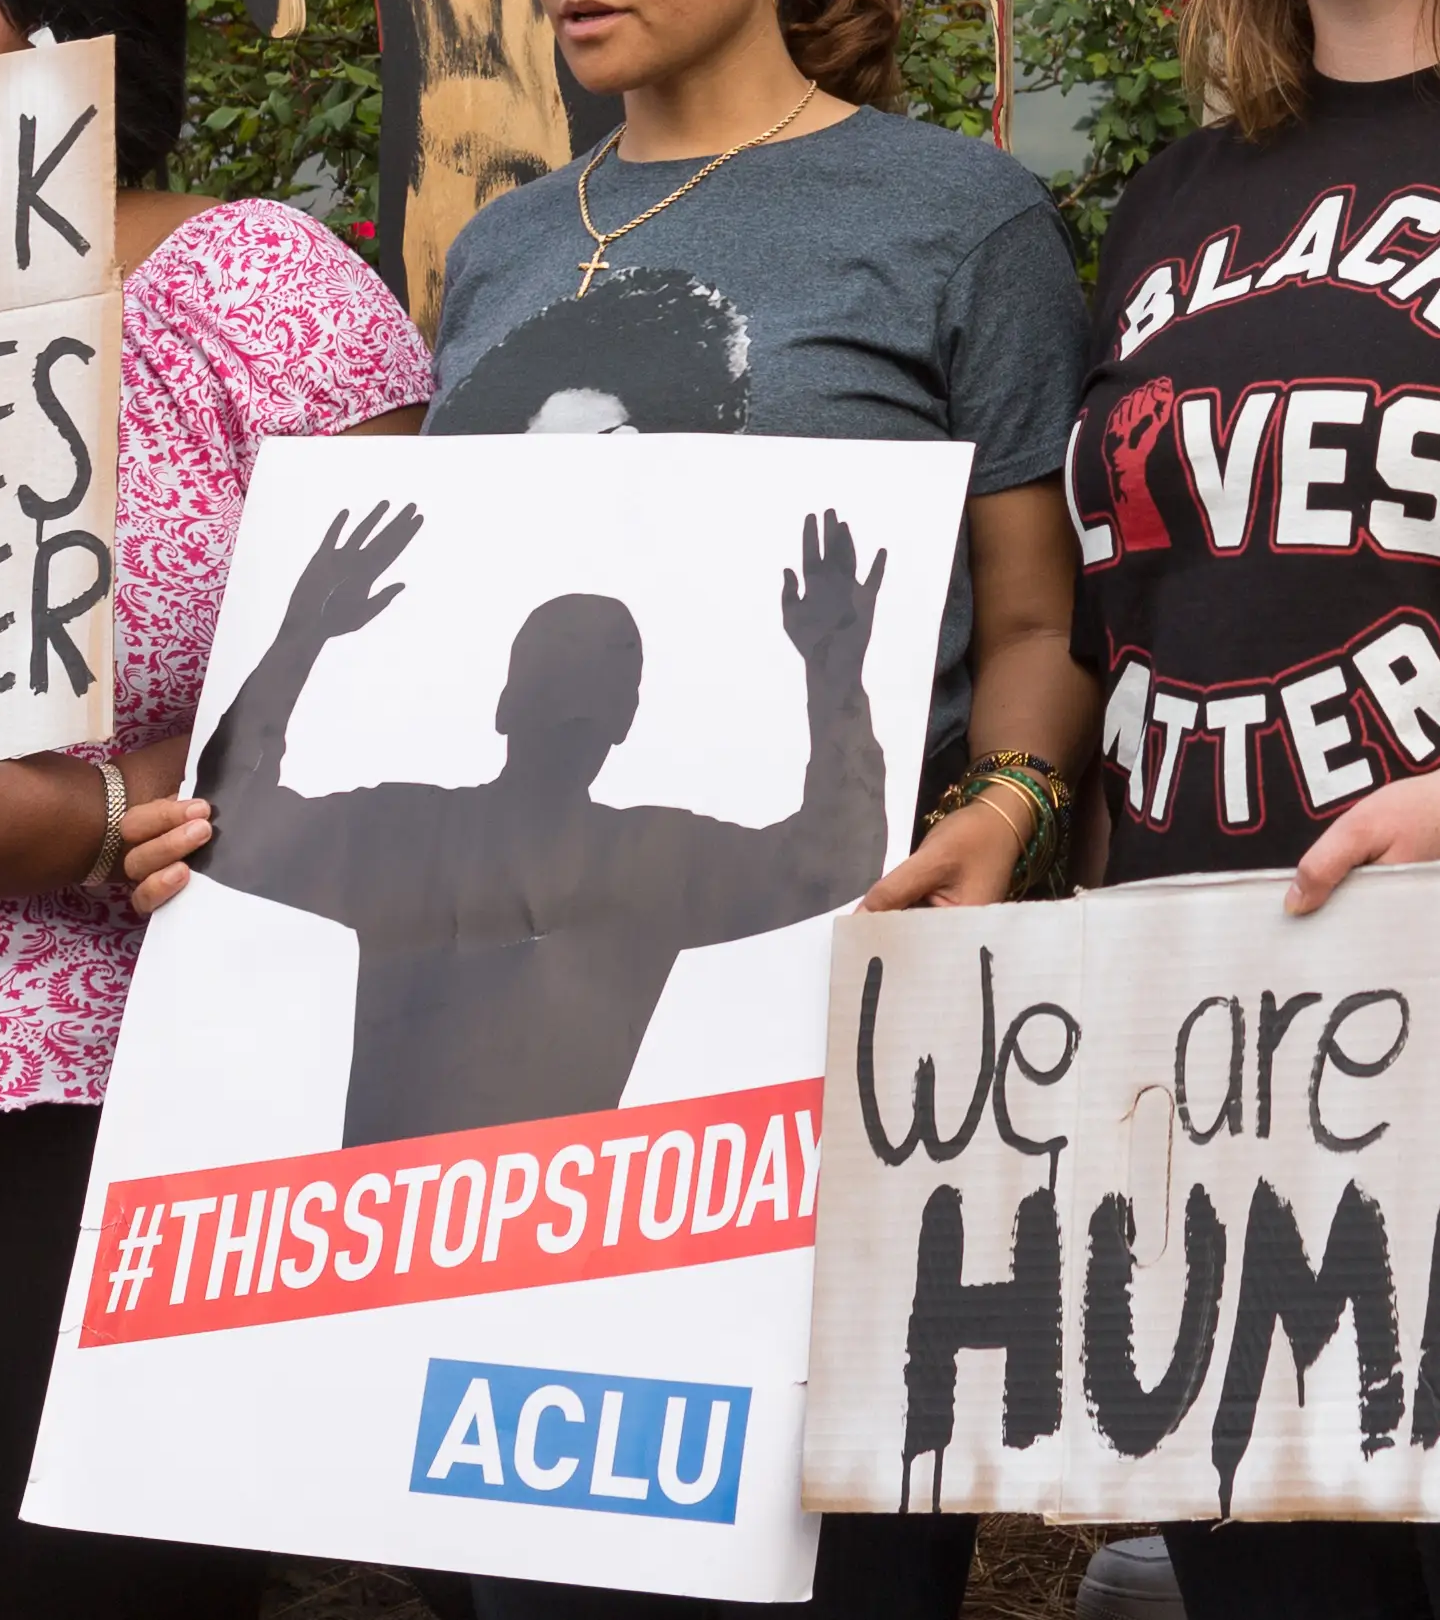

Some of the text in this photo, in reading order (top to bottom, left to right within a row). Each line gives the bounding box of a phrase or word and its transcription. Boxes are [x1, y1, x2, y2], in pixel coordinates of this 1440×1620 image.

[856, 946, 1081, 1167] We
[1175, 987, 1410, 1154] are
[105, 1109, 822, 1313] #THISSTOPSTODAY
[426, 1377, 731, 1505] ACLU
